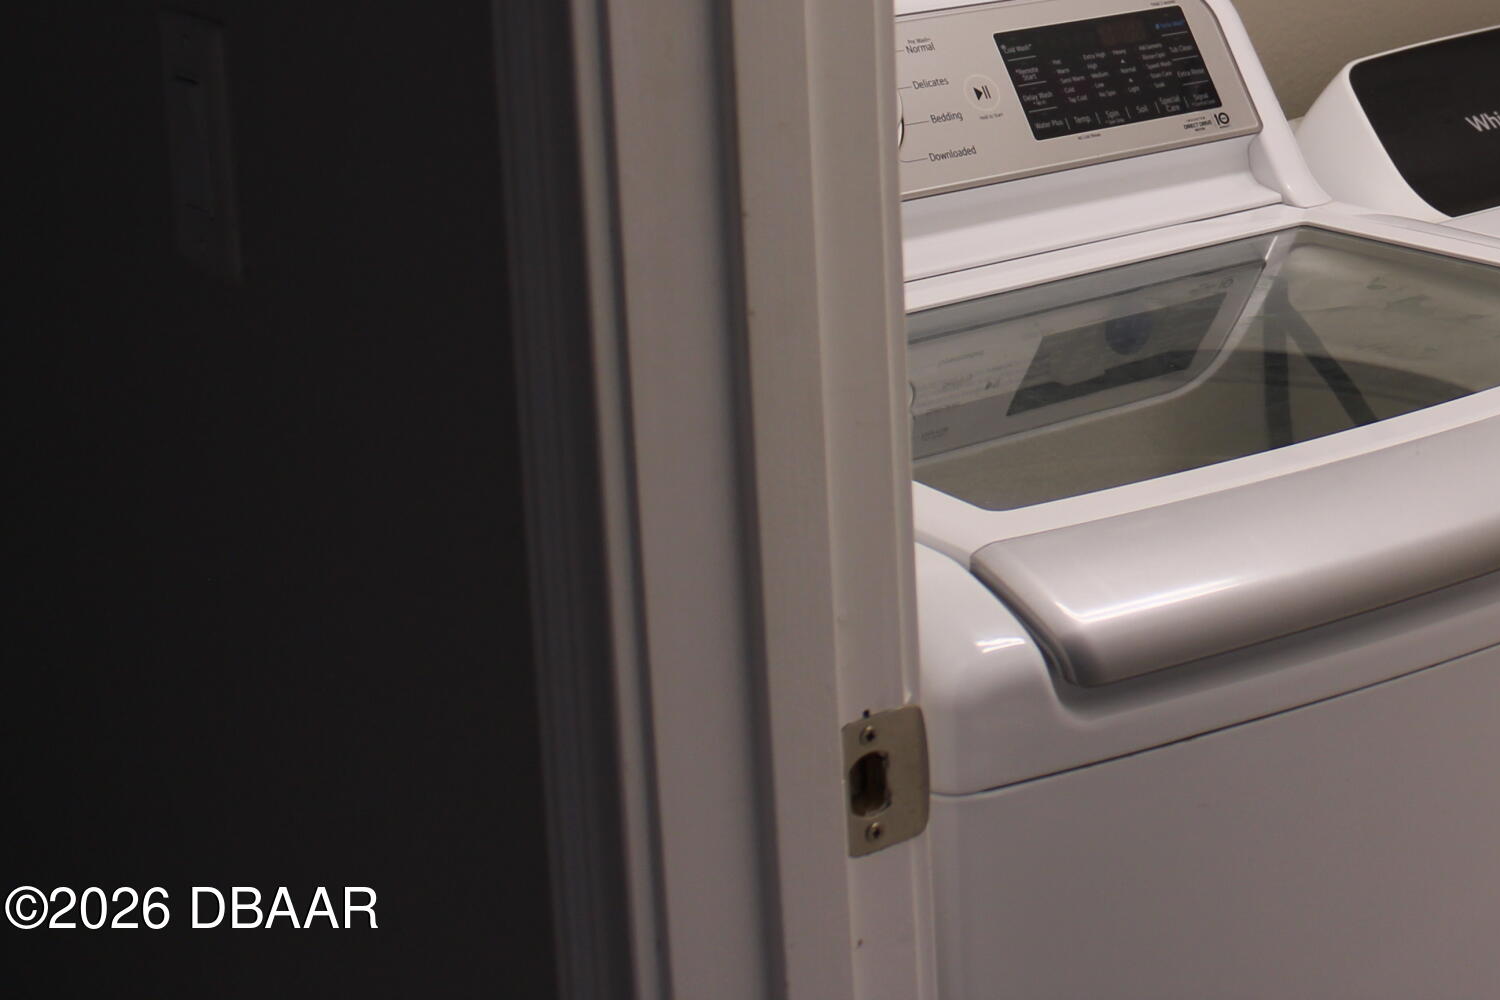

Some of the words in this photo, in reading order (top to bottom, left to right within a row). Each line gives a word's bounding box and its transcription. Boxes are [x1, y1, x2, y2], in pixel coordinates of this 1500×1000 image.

[905, 42, 936, 54] Normal
[912, 77, 950, 90] Delicates
[930, 111, 964, 124] Bedding
[928, 145, 977, 162] Downloaded
